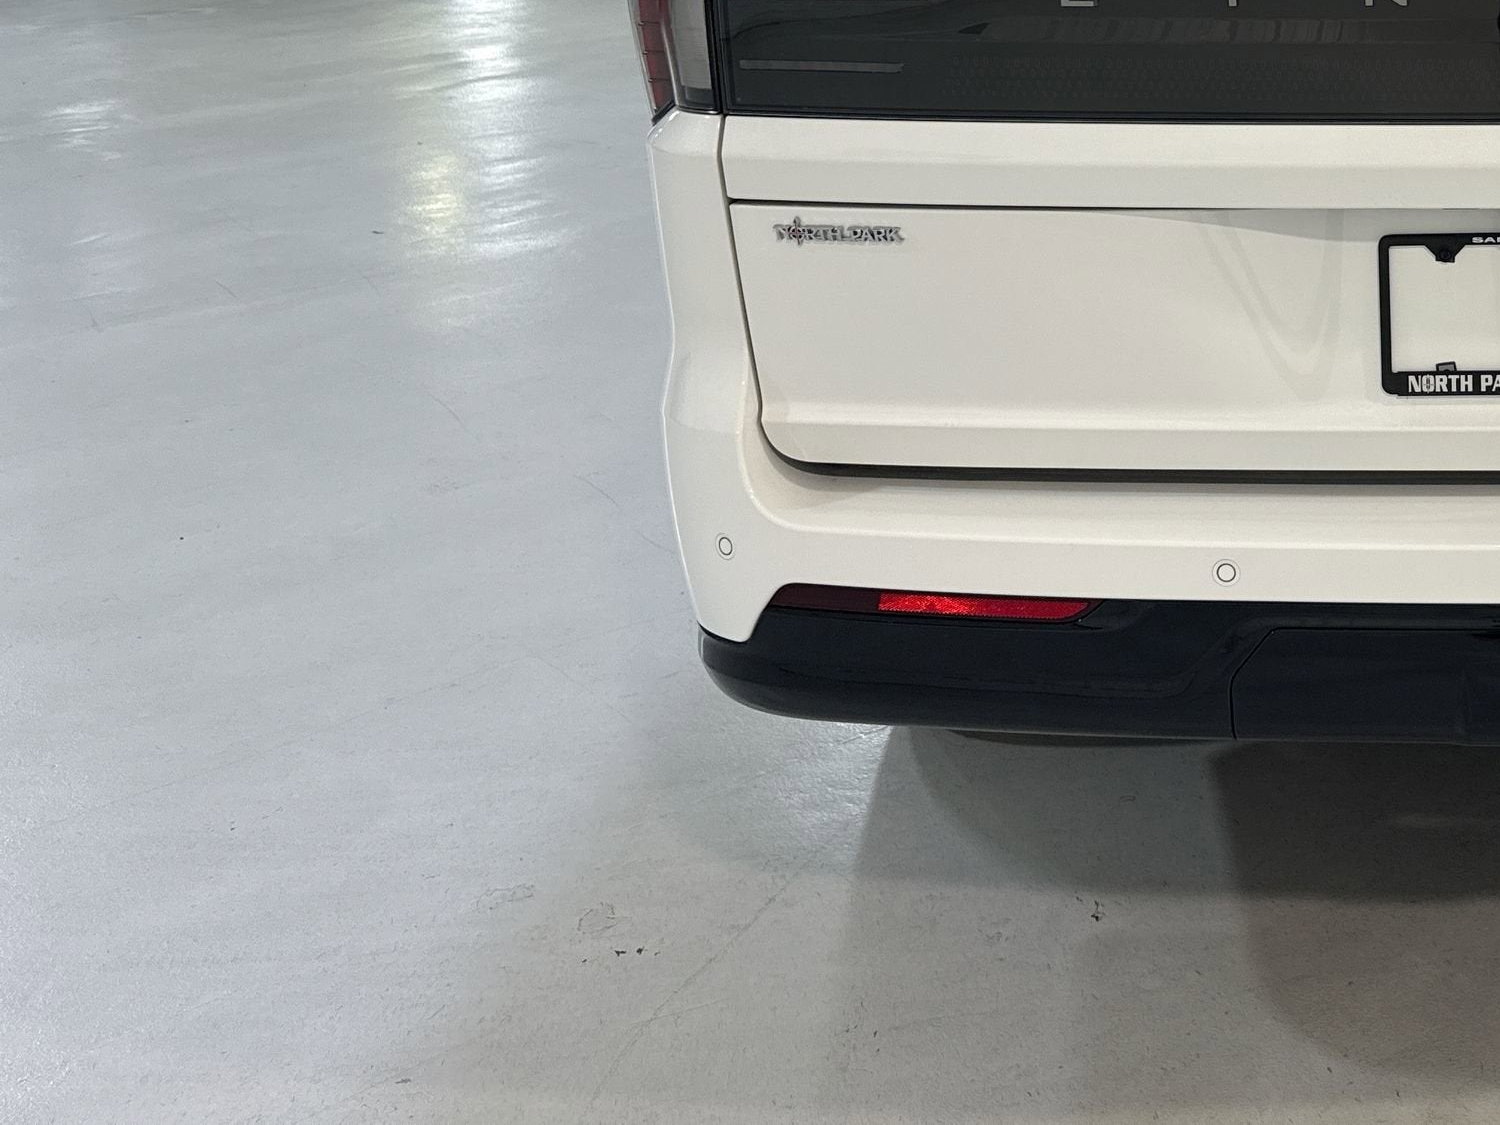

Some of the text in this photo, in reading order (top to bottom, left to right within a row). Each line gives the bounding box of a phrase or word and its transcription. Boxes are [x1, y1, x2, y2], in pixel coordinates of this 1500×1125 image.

[773, 221, 905, 243] NORTH PARK
[1408, 374, 1473, 394] NORTH
